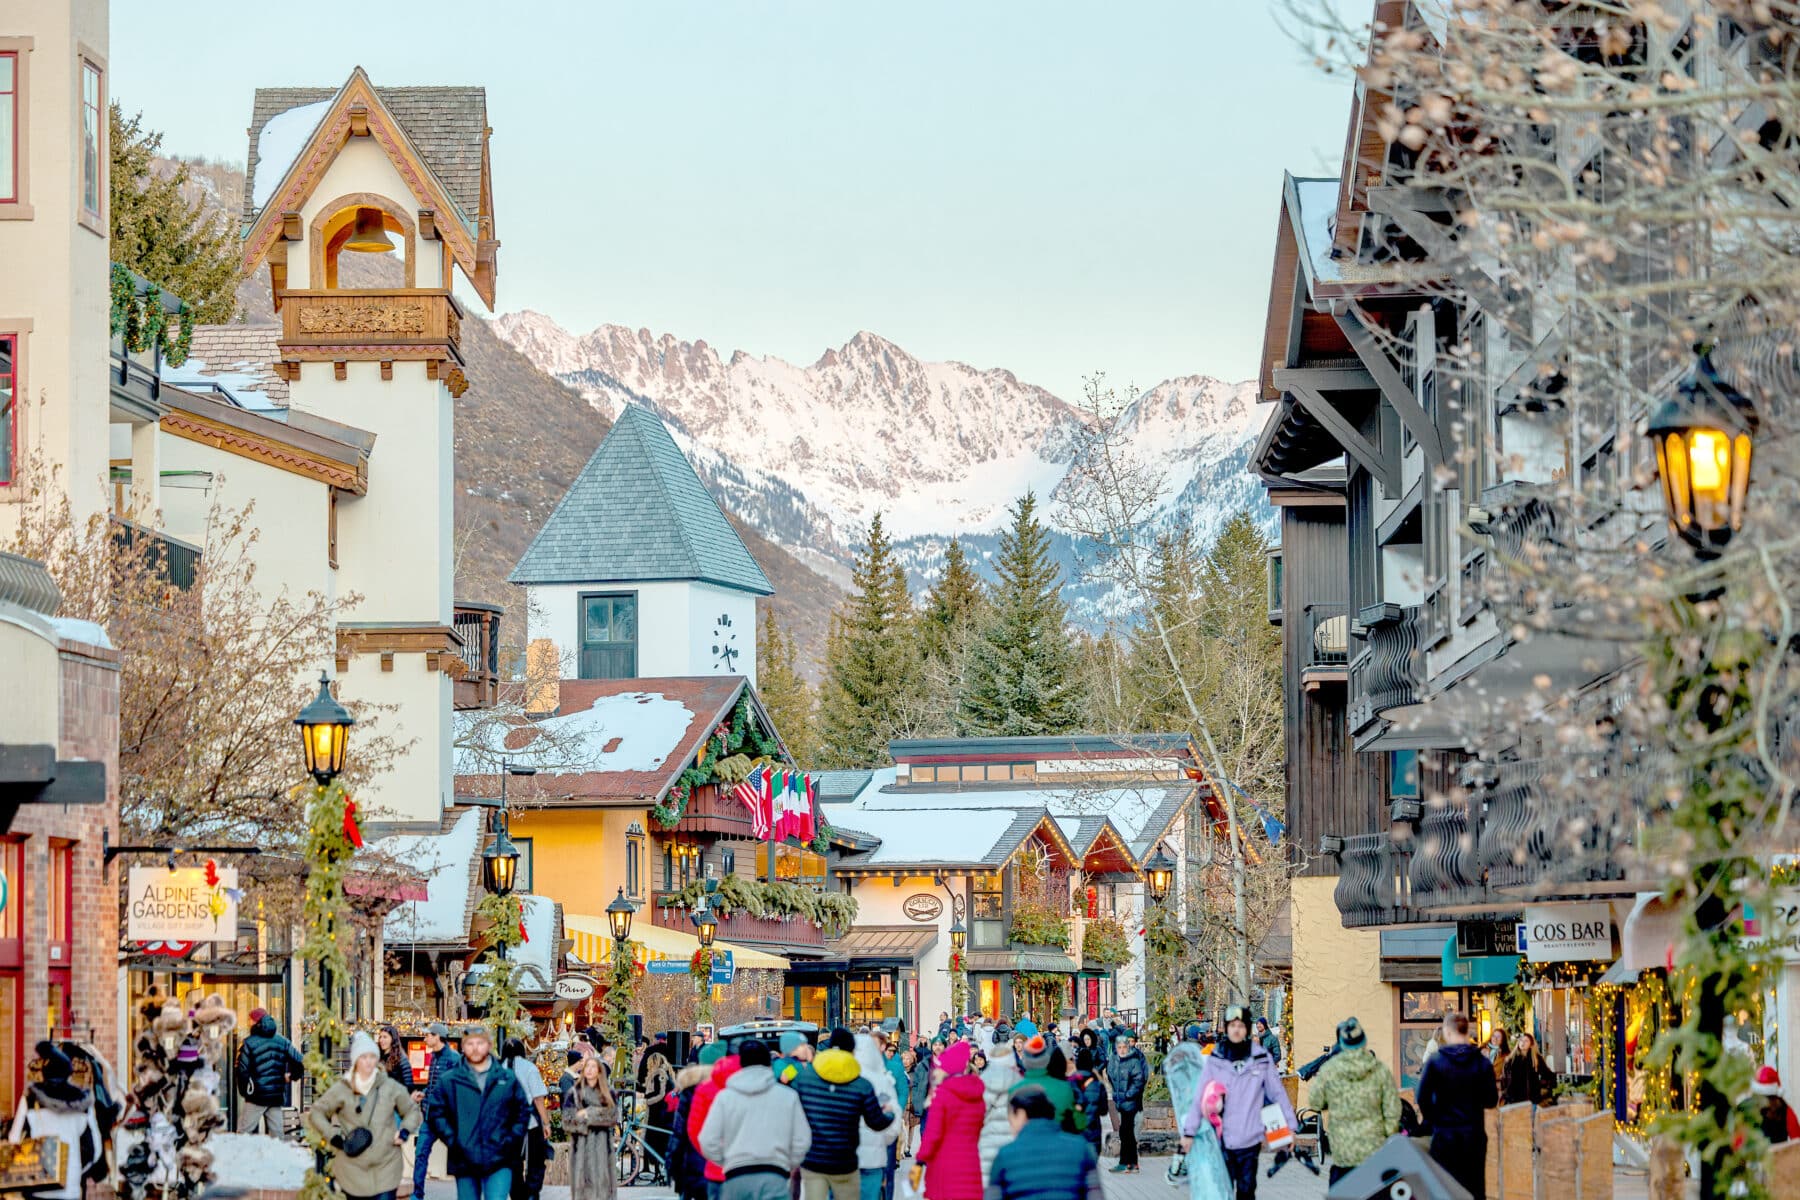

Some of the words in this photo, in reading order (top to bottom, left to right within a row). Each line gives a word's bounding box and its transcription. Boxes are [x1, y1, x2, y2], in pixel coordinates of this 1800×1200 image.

[143, 884, 198, 902] ALPINE
[133, 900, 208, 919] GARDENS
[1493, 922, 1512, 933] Vail
[1534, 923, 1566, 942] COS
[1572, 921, 1605, 940] BAR
[1494, 932, 1515, 942] Fine
